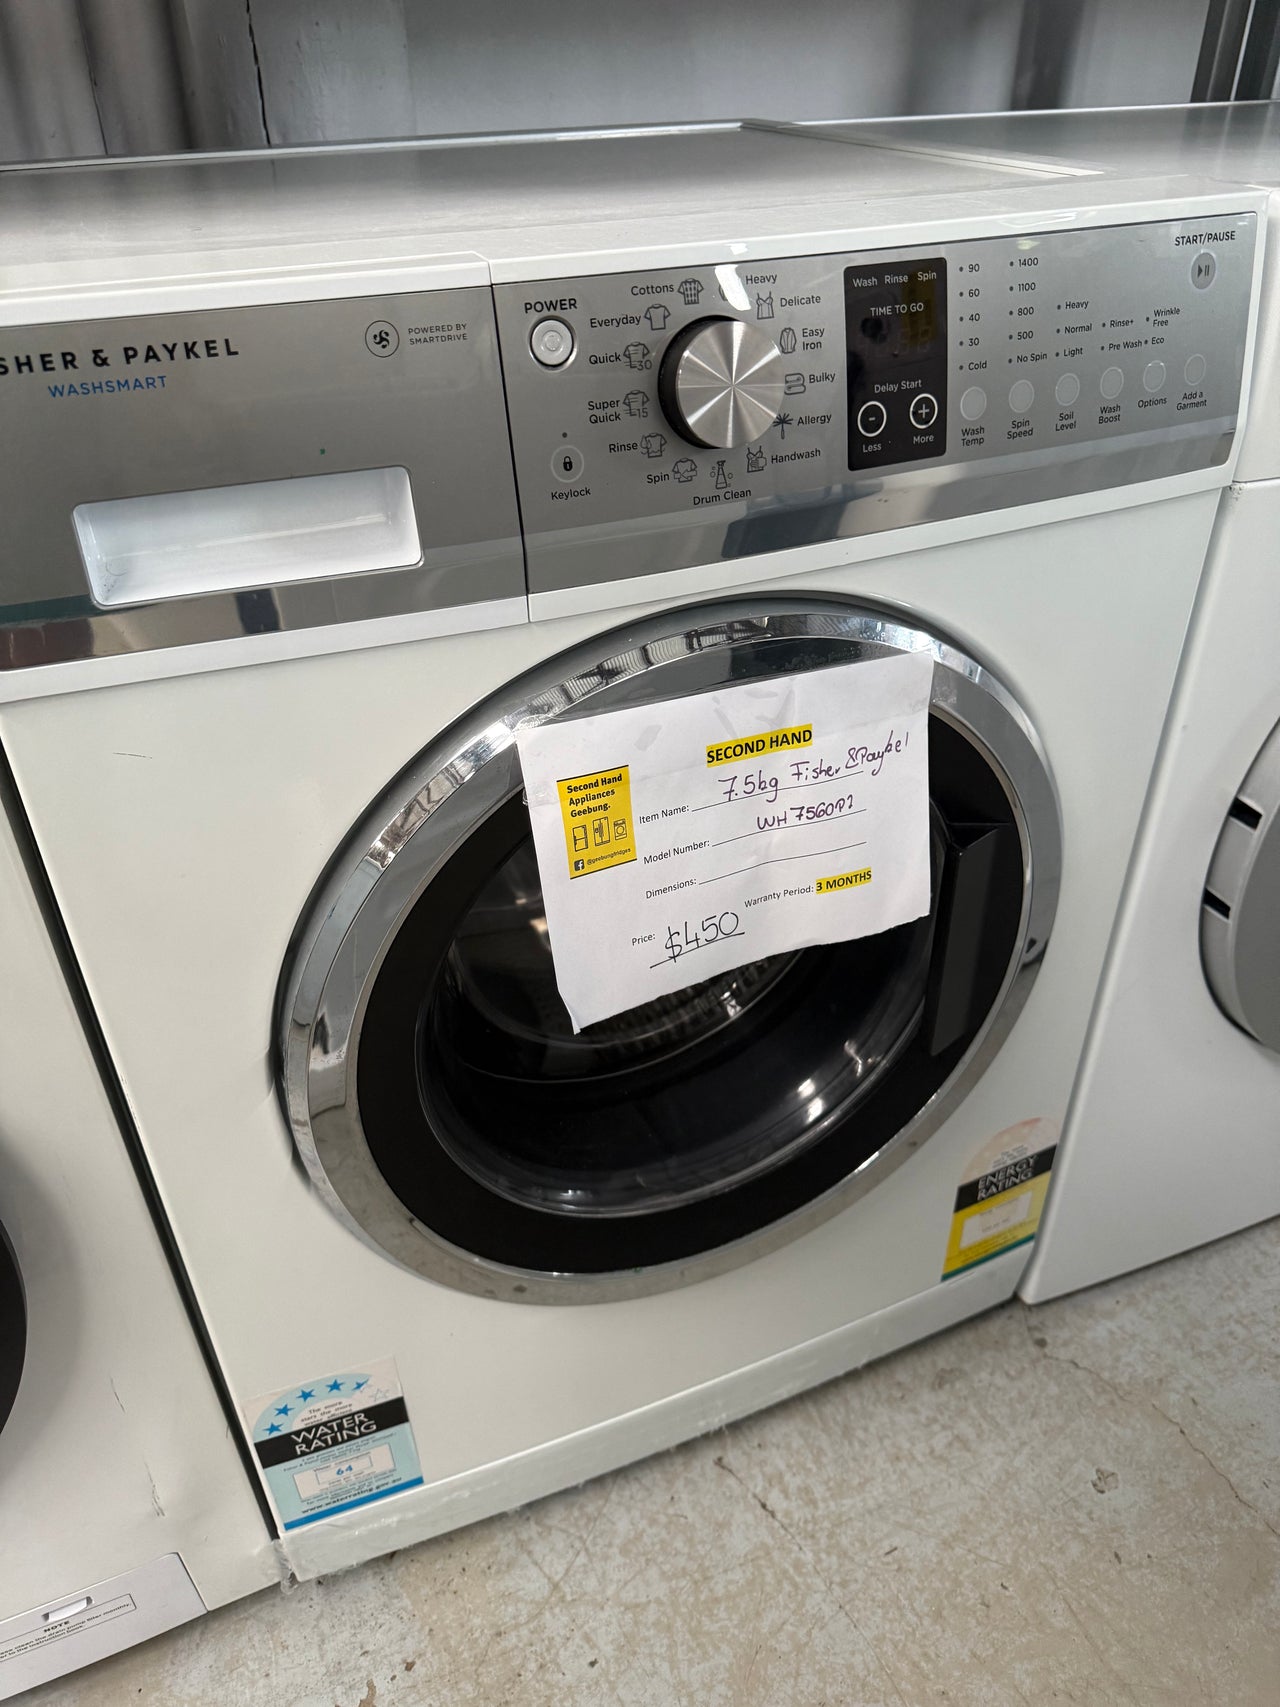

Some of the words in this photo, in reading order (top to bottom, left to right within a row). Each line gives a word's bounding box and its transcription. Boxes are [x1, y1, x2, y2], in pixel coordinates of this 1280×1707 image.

[1175, 230, 1236, 246] START/PAUSE
[968, 264, 980, 272] 90
[1018, 258, 1038, 268] 1400
[745, 274, 778, 285] Heavy
[853, 276, 878, 288] Wash
[885, 274, 909, 284] Rinse
[917, 271, 937, 282] Spin
[631, 284, 675, 296] Cottons
[968, 289, 980, 298] 60
[1018, 283, 1036, 292] 1100
[524, 298, 578, 313] POWER
[780, 294, 821, 308] Delicate
[1065, 300, 1089, 310] Heavy
[870, 306, 892, 316] TIME
[894, 305, 907, 313] TO
[910, 303, 924, 312] GO
[1017, 307, 1034, 316] 800
[1153, 307, 1180, 317] Wrinkle
[590, 314, 641, 328] Everyday
[969, 314, 980, 322] 40
[1110, 319, 1134, 328] Rinse+
[1153, 319, 1169, 328] Free
[408, 324, 453, 335] POWERED
[455, 322, 467, 332] BY
[802, 327, 825, 338] Easy
[1064, 323, 1092, 334] Normal
[409, 333, 468, 345] SMARTDRIVE
[1017, 331, 1034, 340] 500
[1152, 336, 1164, 345] Eco
[803, 341, 822, 351] Iron
[968, 338, 980, 346] 30
[1108, 343, 1121, 352] Pre
[1122, 340, 1142, 349] Wash
[0, 351, 79, 376] SHER
[92, 349, 111, 368] &
[123, 338, 239, 364] PAYKEL
[1017, 355, 1028, 364] No
[1030, 352, 1047, 363] Spin
[1063, 347, 1083, 358] Light
[589, 352, 622, 365] Quick
[637, 360, 652, 371] 30
[968, 361, 987, 371] Cold
[809, 372, 835, 384] Bulky
[48, 375, 167, 398] WASHSMART
[874, 382, 899, 394] Delay
[901, 379, 922, 390] Start
[1138, 396, 1167, 408] Options
[1182, 392, 1197, 401] Add
[588, 400, 620, 411] Super
[1100, 404, 1121, 414] Wash
[1176, 399, 1207, 411] Garment
[589, 412, 621, 424] Quick
[637, 408, 648, 418] 15
[1059, 411, 1074, 421] Soil
[797, 413, 832, 426] Allergy
[1011, 419, 1030, 430] Spin
[1098, 414, 1121, 425] Boost
[961, 426, 985, 437] Wash
[1055, 421, 1076, 432] Level
[913, 434, 934, 444] More
[1007, 429, 1033, 440] Speed
[609, 441, 638, 453] Rinse
[961, 436, 985, 447] Temp
[863, 443, 882, 453] Less
[771, 448, 821, 464] Handwash
[647, 472, 670, 485] Spin
[551, 487, 591, 500] Keylock
[693, 493, 721, 506] Drum
[724, 488, 752, 501] Clean
[707, 739, 765, 763] SECOND
[769, 730, 812, 749] HAND
[790, 759, 841, 781] Fisher
[567, 780, 599, 794] Second
[601, 773, 622, 786] Hand
[569, 788, 615, 806] Appliances
[570, 802, 611, 818] Geebung.
[639, 812, 660, 825] Item
[661, 804, 690, 818] Name:
[586, 847, 631, 865] @geebungfridges
[643, 849, 671, 865] Model
[673, 839, 710, 856] Number:
[645, 878, 697, 900] Dimensions:
[744, 892, 781, 908] Warranty
[783, 885, 814, 898] Period:
[816, 882, 823, 892] 3
[826, 870, 872, 890] MONTHS
[632, 933, 656, 946] Price:
[665, 911, 739, 963] $450
[978, 1154, 1038, 1189] ENERGY
[977, 1168, 1033, 1200] RATING
[291, 1413, 368, 1443] WATER
[295, 1420, 377, 1455] RATING
[43, 1620, 70, 1633] NOTE
